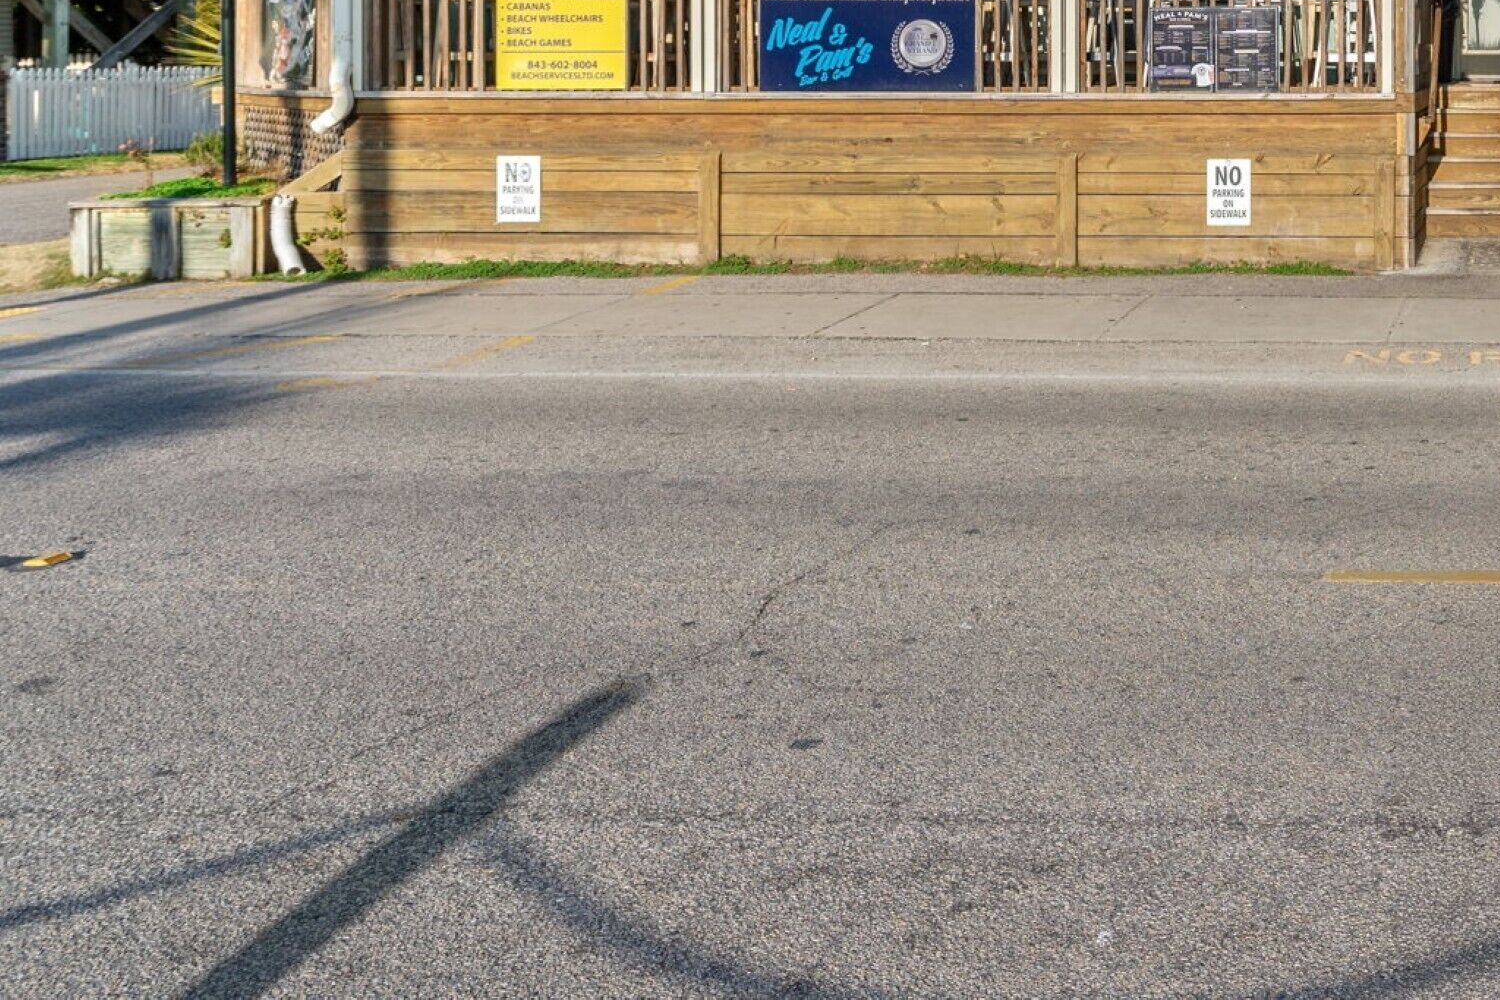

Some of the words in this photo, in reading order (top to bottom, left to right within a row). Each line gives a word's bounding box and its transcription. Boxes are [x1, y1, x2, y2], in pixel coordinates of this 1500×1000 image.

[506, 27, 532, 35] BIKES
[766, 7, 832, 51] Neal
[829, 23, 848, 45] &
[506, 39, 536, 47] BEACH
[539, 39, 572, 47] GAMES
[795, 37, 873, 77] Pam's
[528, 61, 598, 69] 843-602-8004
[511, 72, 614, 80] BEACHSERVICESLTD.COM
[505, 162, 532, 182] NO
[1215, 166, 1242, 186] NO
[1212, 189, 1245, 198] PARKING
[1223, 199, 1234, 207] ON
[1210, 209, 1247, 218] SIDEWALK
[1344, 349, 1442, 366] NO
